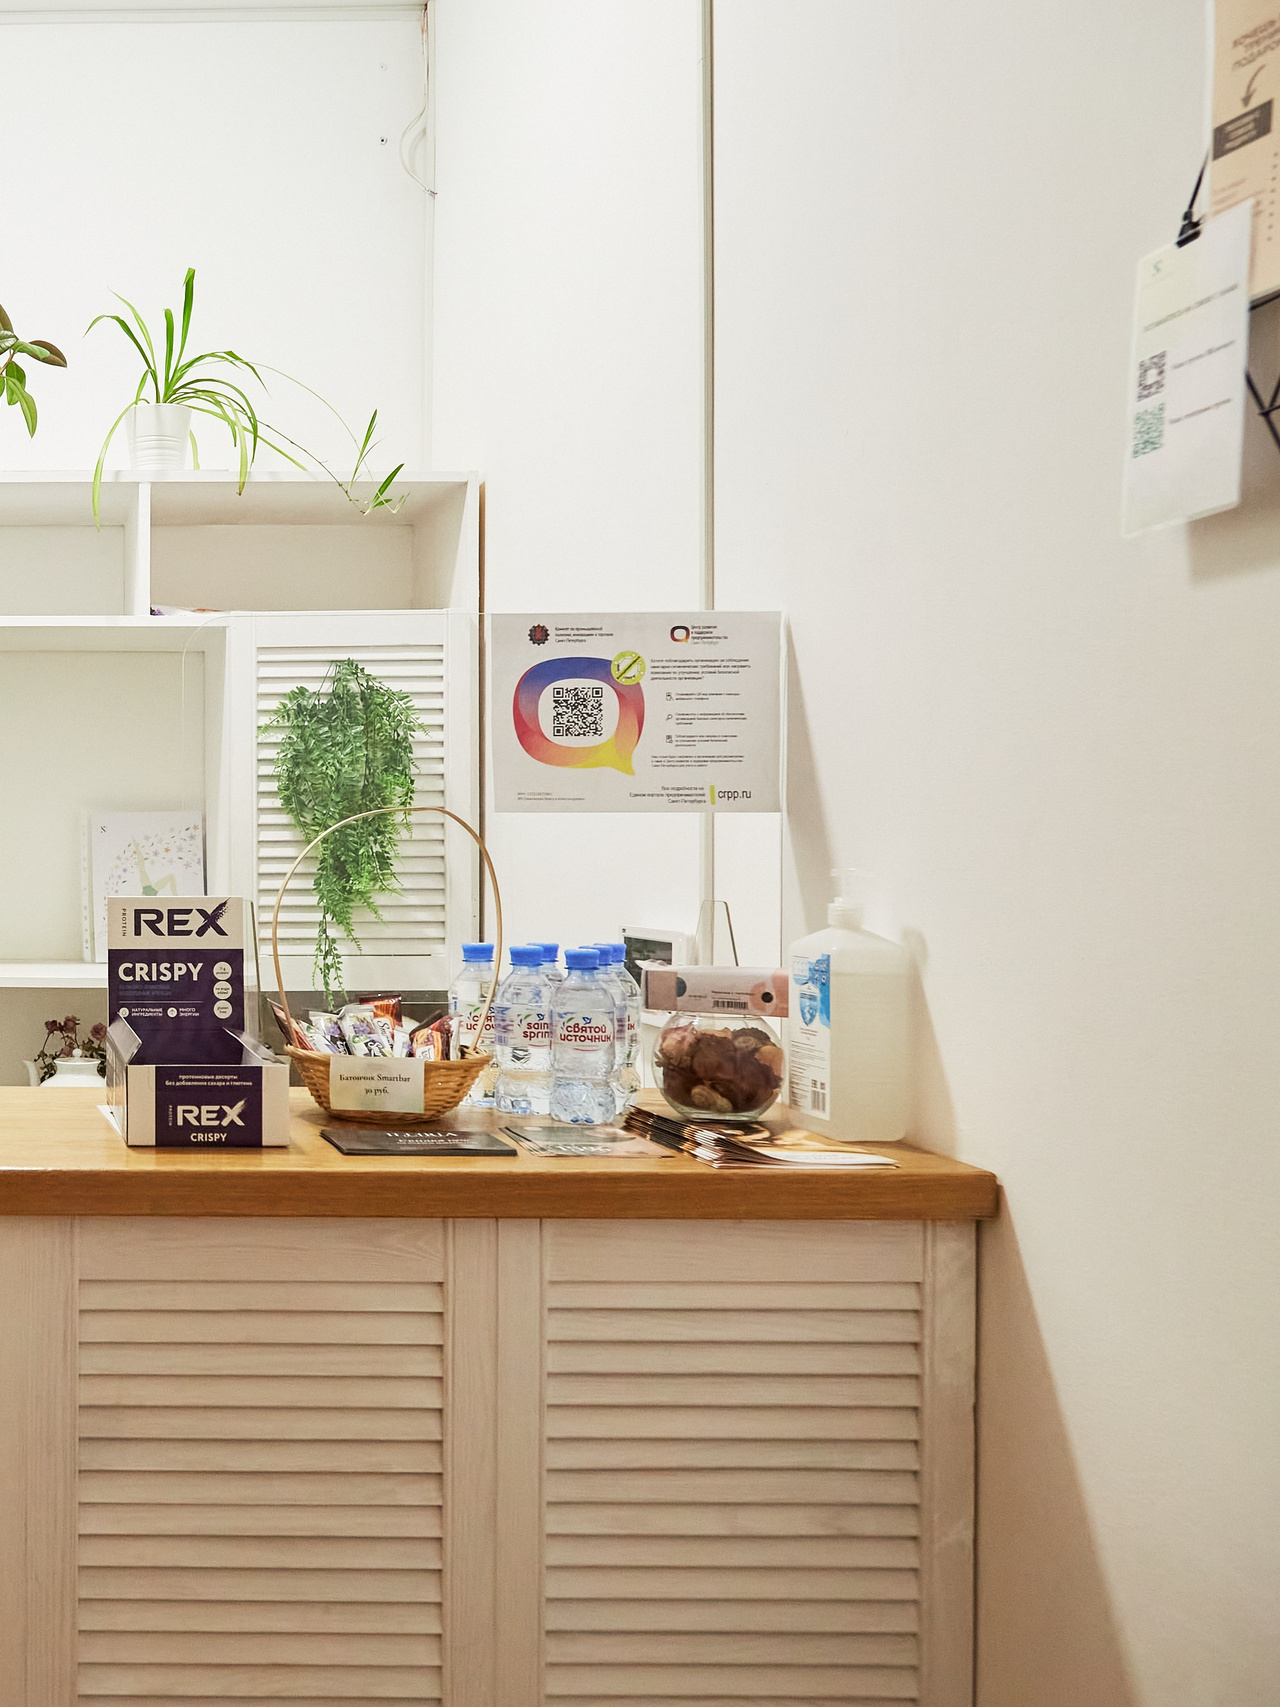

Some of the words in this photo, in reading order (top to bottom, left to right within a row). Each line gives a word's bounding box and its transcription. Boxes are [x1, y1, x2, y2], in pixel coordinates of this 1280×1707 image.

[717, 790, 751, 801] crpp.ru
[134, 897, 232, 937] REX
[118, 962, 204, 982] CRISPY
[527, 1022, 550, 1030] sain
[523, 1030, 550, 1041] sprin
[377, 1073, 411, 1082] Smartbar
[374, 1086, 390, 1096] руб.
[177, 1097, 247, 1127] REX
[190, 1133, 227, 1142] CRISPY
